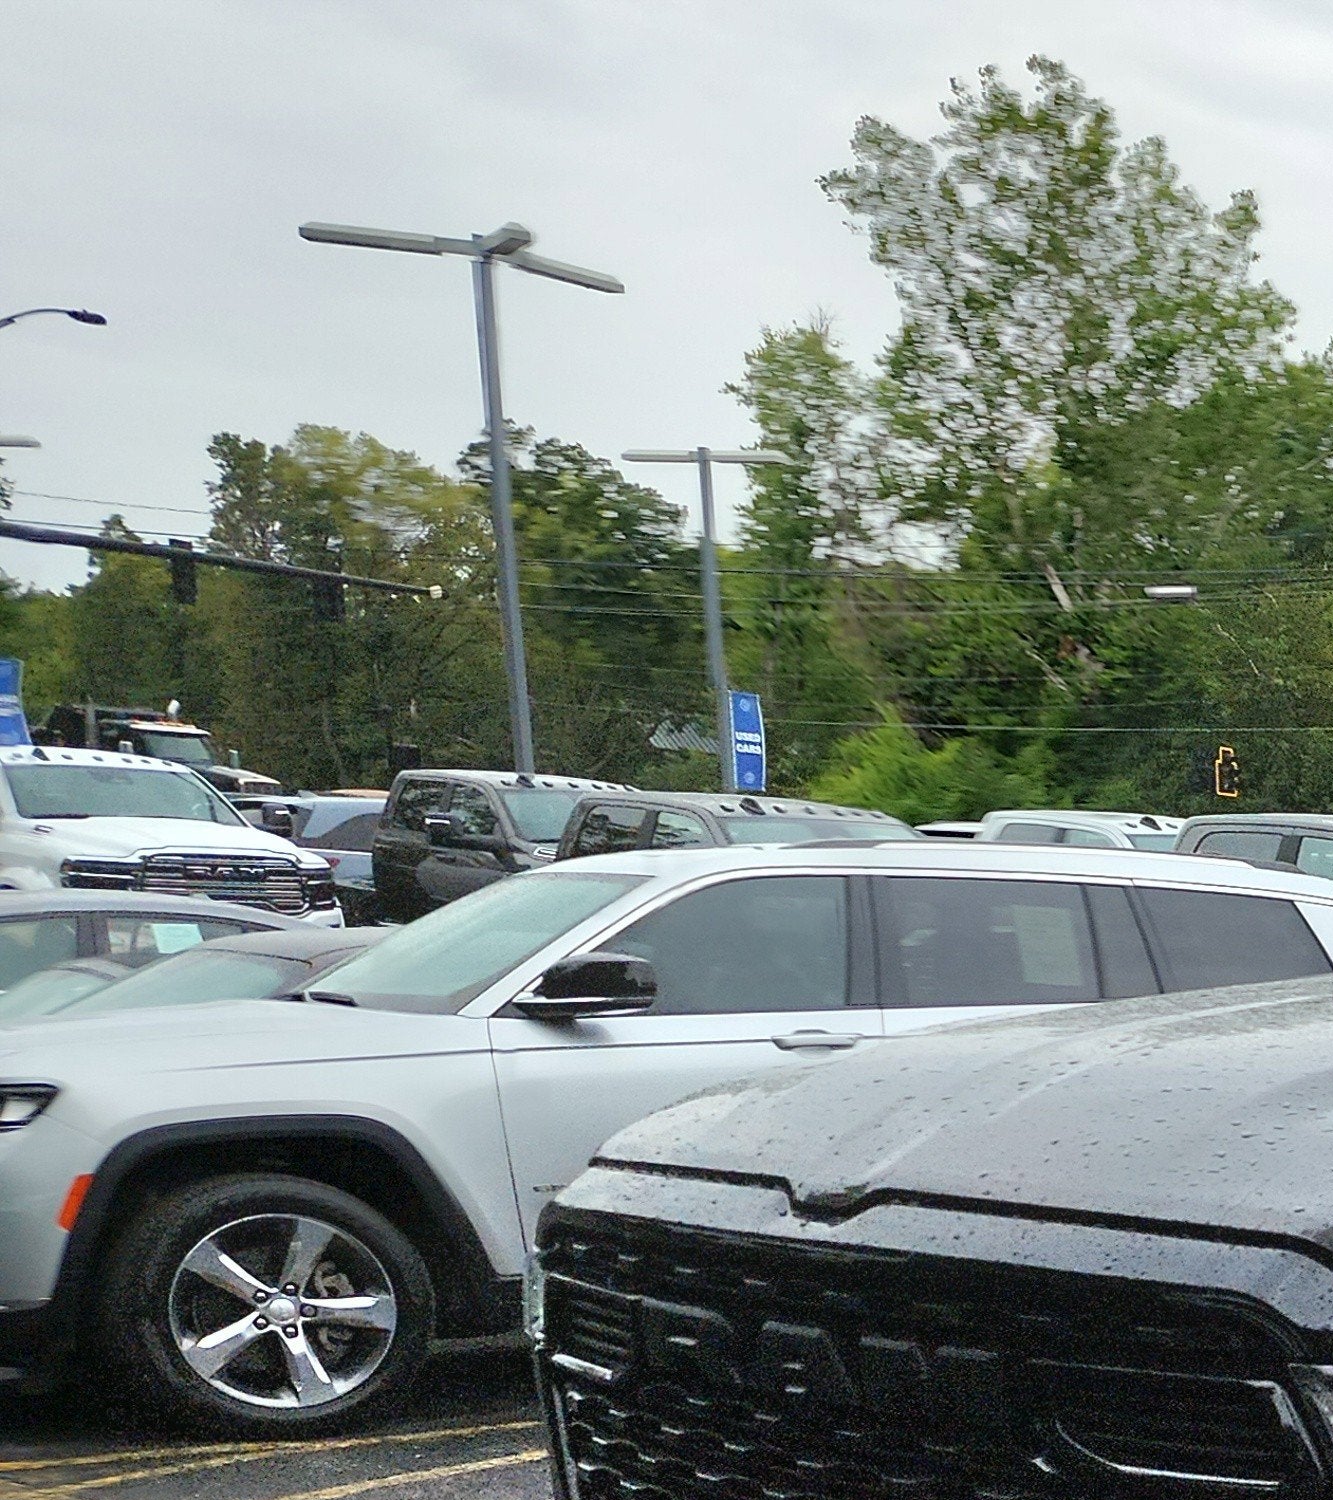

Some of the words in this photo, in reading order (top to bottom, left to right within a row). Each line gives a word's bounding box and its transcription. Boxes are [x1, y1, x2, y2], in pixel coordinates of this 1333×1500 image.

[735, 731, 760, 742] USED
[736, 743, 761, 754] CARS
[635, 1291, 1008, 1405] RAM
